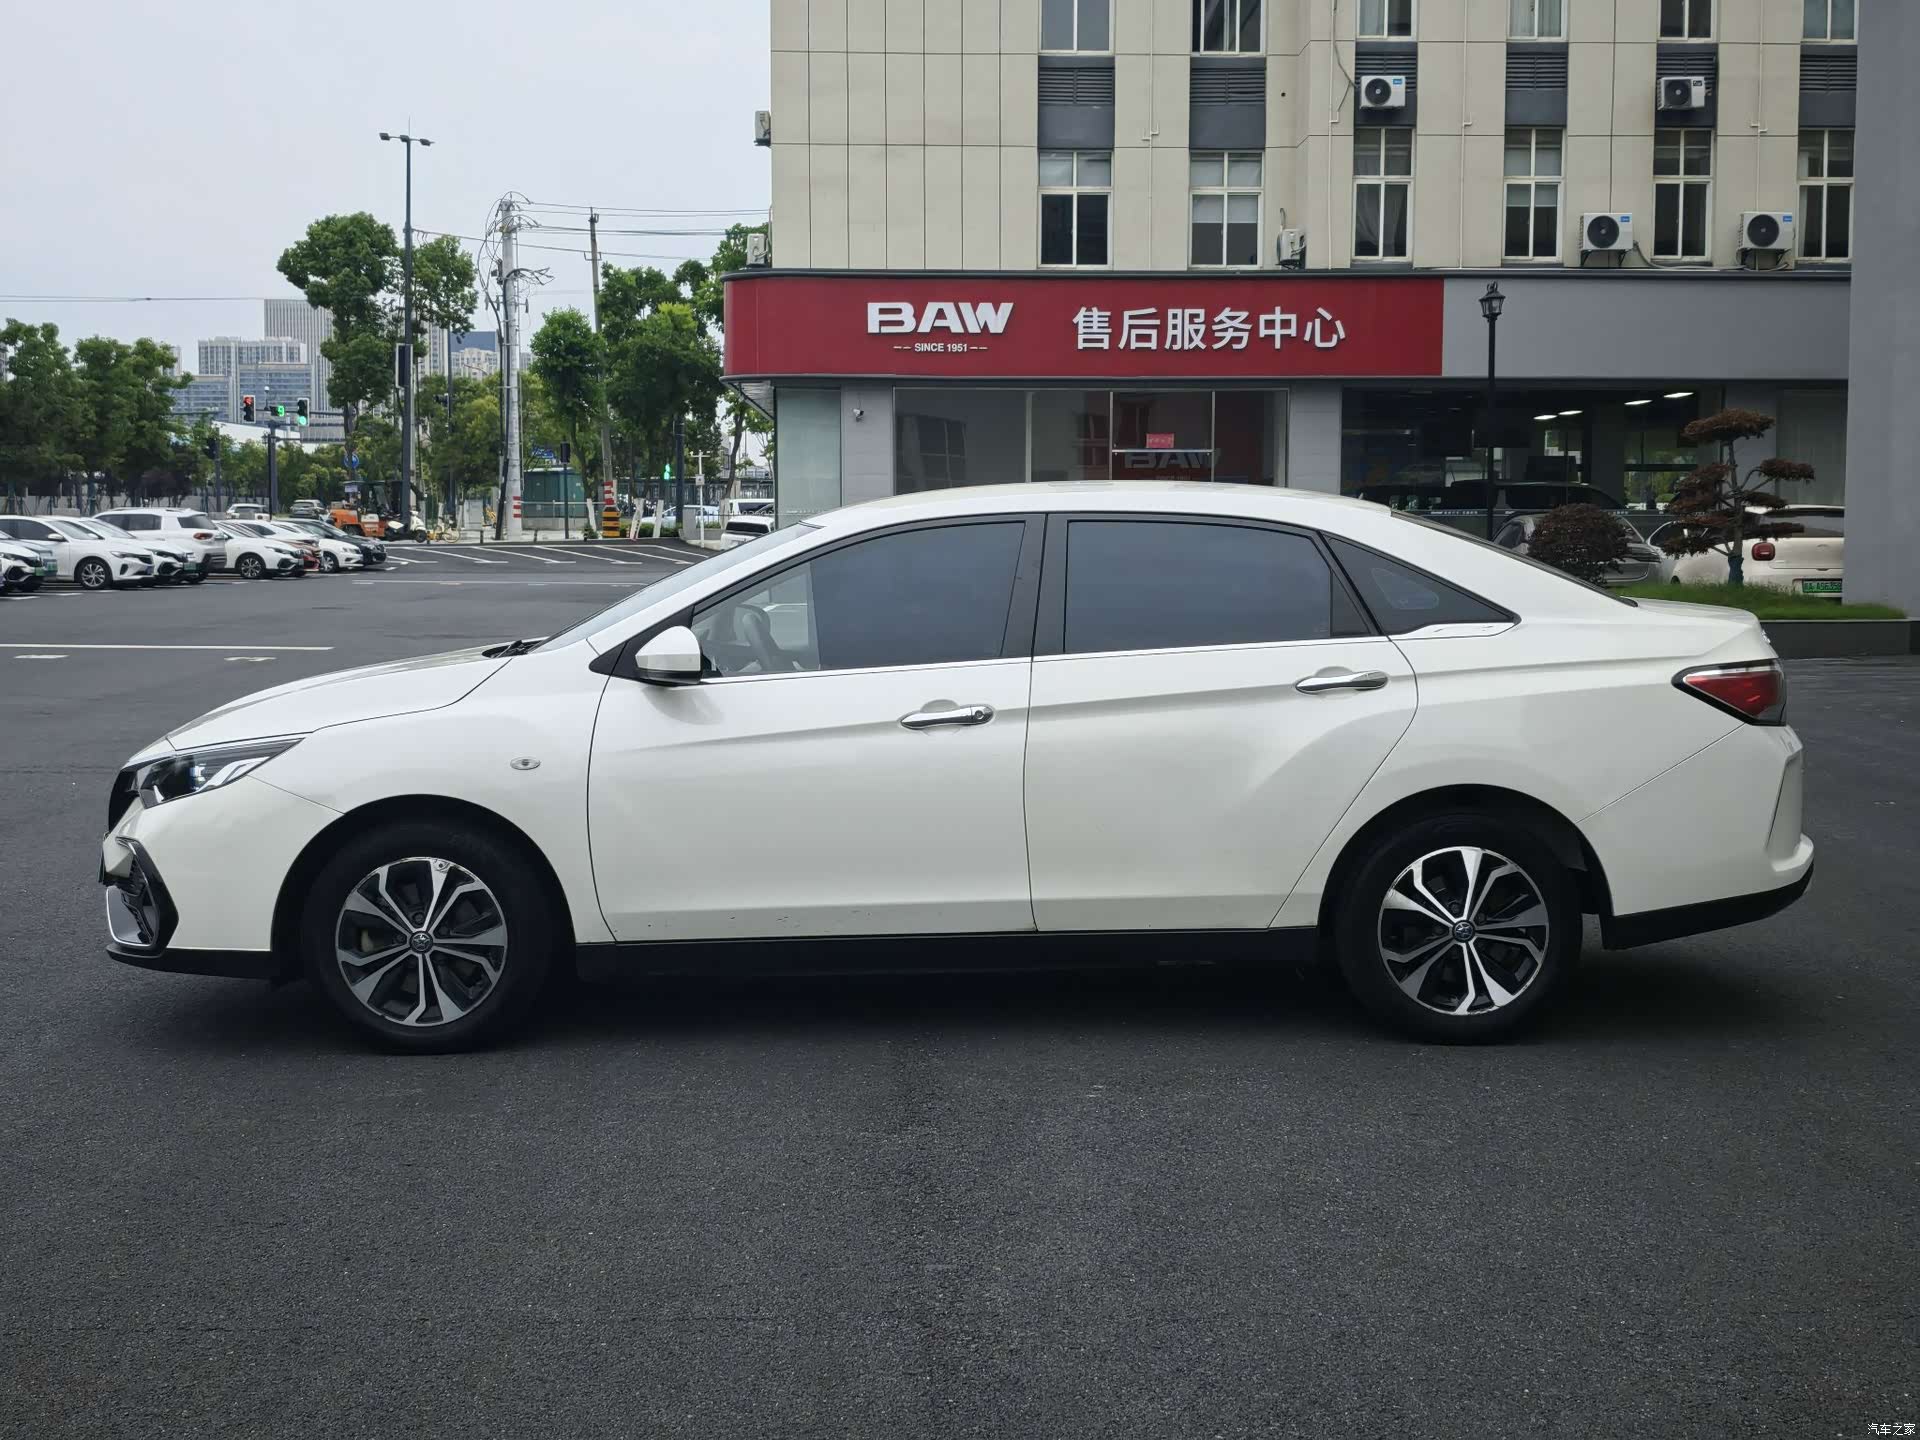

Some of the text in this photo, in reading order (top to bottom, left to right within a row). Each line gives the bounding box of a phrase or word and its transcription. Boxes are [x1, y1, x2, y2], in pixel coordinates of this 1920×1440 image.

[867, 302, 1014, 334] BAW
[1072, 306, 1346, 350] 售后服务中心
[914, 343, 968, 352] SINCE 1951
